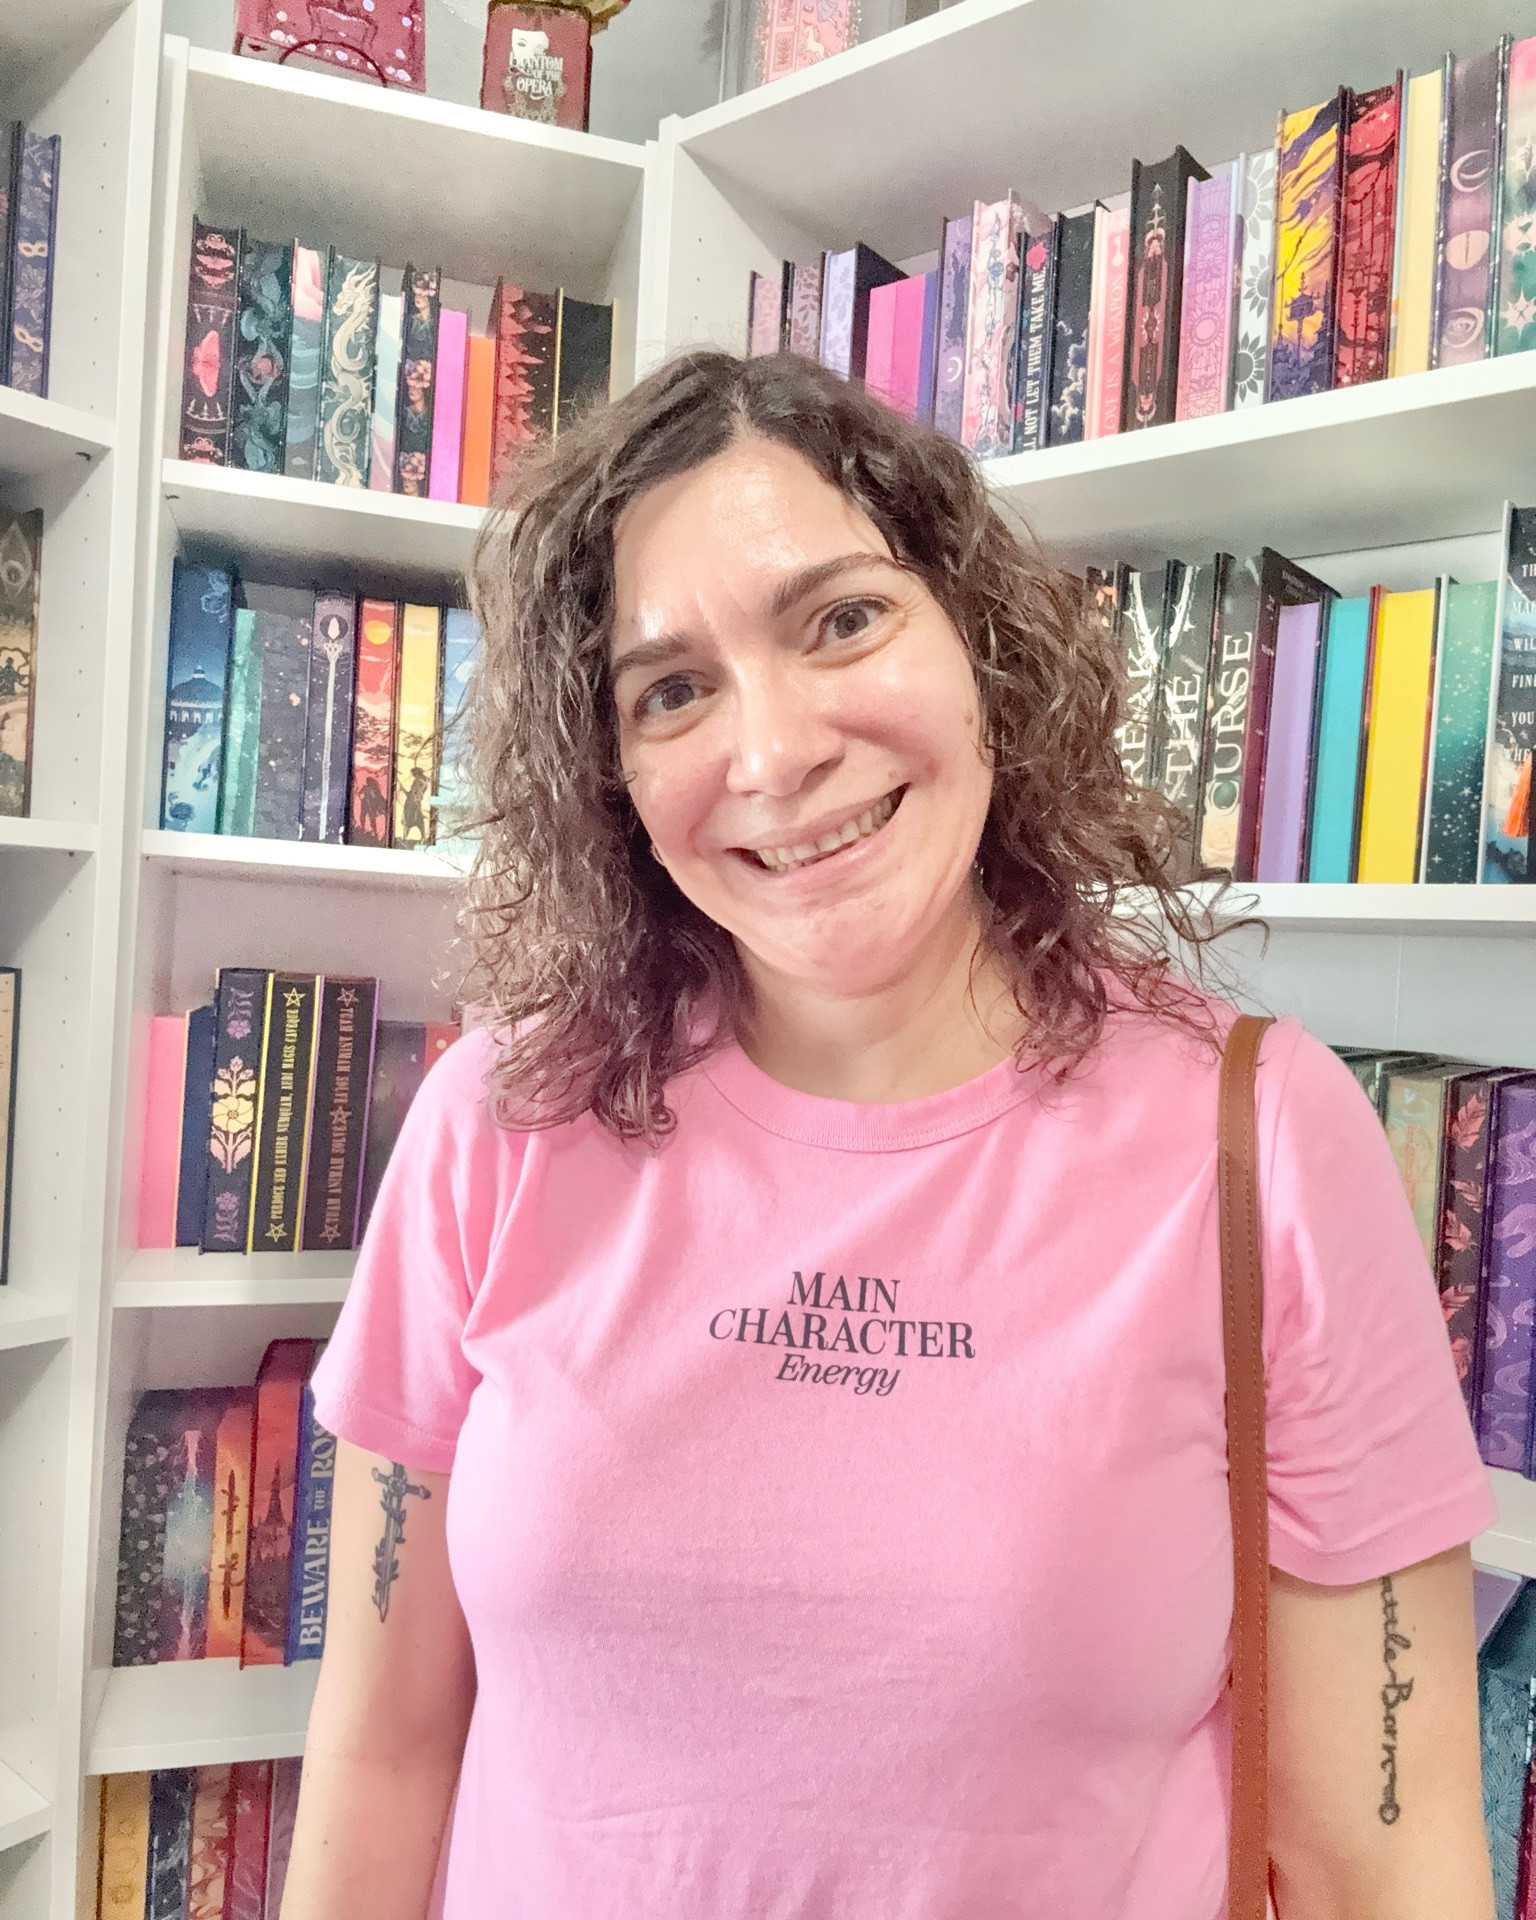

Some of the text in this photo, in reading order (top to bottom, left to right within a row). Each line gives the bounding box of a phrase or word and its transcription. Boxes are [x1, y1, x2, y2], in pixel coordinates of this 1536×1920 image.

[509, 51, 564, 72] PHANTOM
[516, 77, 554, 98] OPERA
[1029, 294, 1045, 334] TAKE
[1027, 334, 1043, 377] THEM
[1103, 273, 1125, 434] OVE IS A WEAPON
[1025, 379, 1040, 408] LET
[1024, 407, 1039, 436] NOT
[1522, 563, 1536, 578] TH
[1513, 637, 1536, 652] WIL
[1511, 674, 1536, 689] FIN
[1120, 646, 1155, 803] REAK
[1165, 673, 1201, 782] THE
[1209, 631, 1253, 816] CURSE
[1511, 711, 1535, 728] YOU
[786, 1271, 901, 1314] MAIN
[708, 1307, 976, 1359] CHARACTER
[775, 1352, 901, 1397] Energy
[300, 1419, 338, 1646] BEWARE THE ROS
